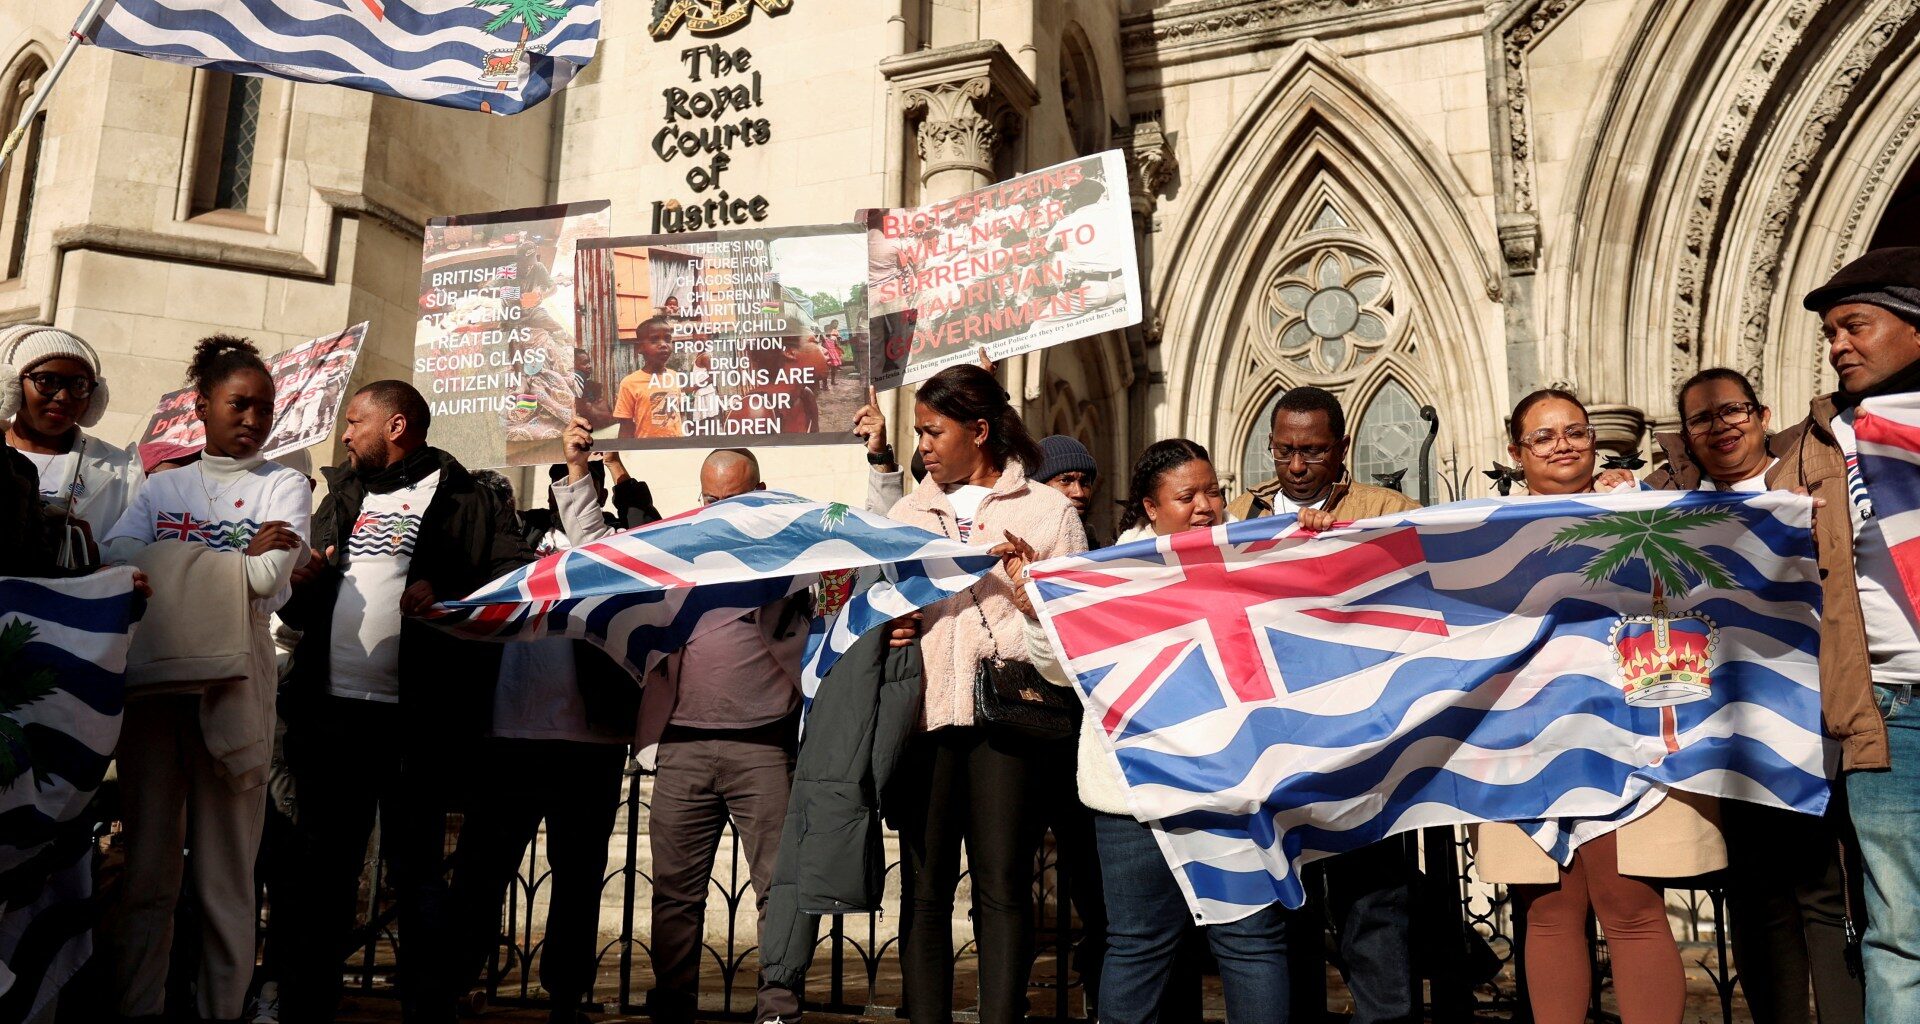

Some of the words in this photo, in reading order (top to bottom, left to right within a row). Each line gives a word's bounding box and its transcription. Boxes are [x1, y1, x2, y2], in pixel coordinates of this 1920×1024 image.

[681, 43, 752, 83] The
[662, 70, 763, 123] Royal
[652, 117, 771, 162] Courts
[686, 152, 731, 193] of
[882, 205, 946, 239] BIOT
[954, 164, 1084, 220] CITIZENS
[897, 233, 968, 267] WILL
[971, 199, 1065, 245] NEVER
[689, 241, 741, 254] THERE'S
[745, 239, 764, 251] NO
[688, 257, 739, 270] FUTURE
[743, 256, 769, 268] FOR
[880, 237, 1048, 304] SURRENDER
[1055, 224, 1095, 251] TO
[432, 267, 496, 287] BRITISH
[676, 273, 763, 287] CHAGOSSIAN
[686, 289, 752, 303] CHILDREN
[757, 288, 770, 299] IN
[901, 260, 1065, 323] MAURITIAN
[680, 302, 761, 317] MAURITIUS
[886, 285, 1091, 360] GOVERNMENT
[428, 330, 502, 349] TREATED
[508, 327, 531, 343] AS
[674, 337, 787, 353] PROSTITUTION,
[920, 360, 939, 370] being
[940, 349, 980, 364] manhandle
[992, 341, 1007, 349] Riot
[1008, 334, 1029, 345] Police
[1039, 328, 1053, 338] they
[1055, 324, 1065, 332] try
[1075, 315, 1095, 326] arrest
[1111, 306, 1127, 317] 1981
[415, 352, 485, 373] SECOND
[489, 348, 546, 367] CLASS
[710, 357, 750, 370] DRUG
[994, 348, 1009, 358] Port
[432, 374, 499, 394] CITIZEN
[504, 371, 522, 388] IN
[648, 368, 769, 389] ADDICTIONS
[774, 367, 815, 385] ARE
[666, 394, 743, 413] KILLING
[749, 392, 791, 410] OUR
[681, 417, 781, 437] CHILDREN
